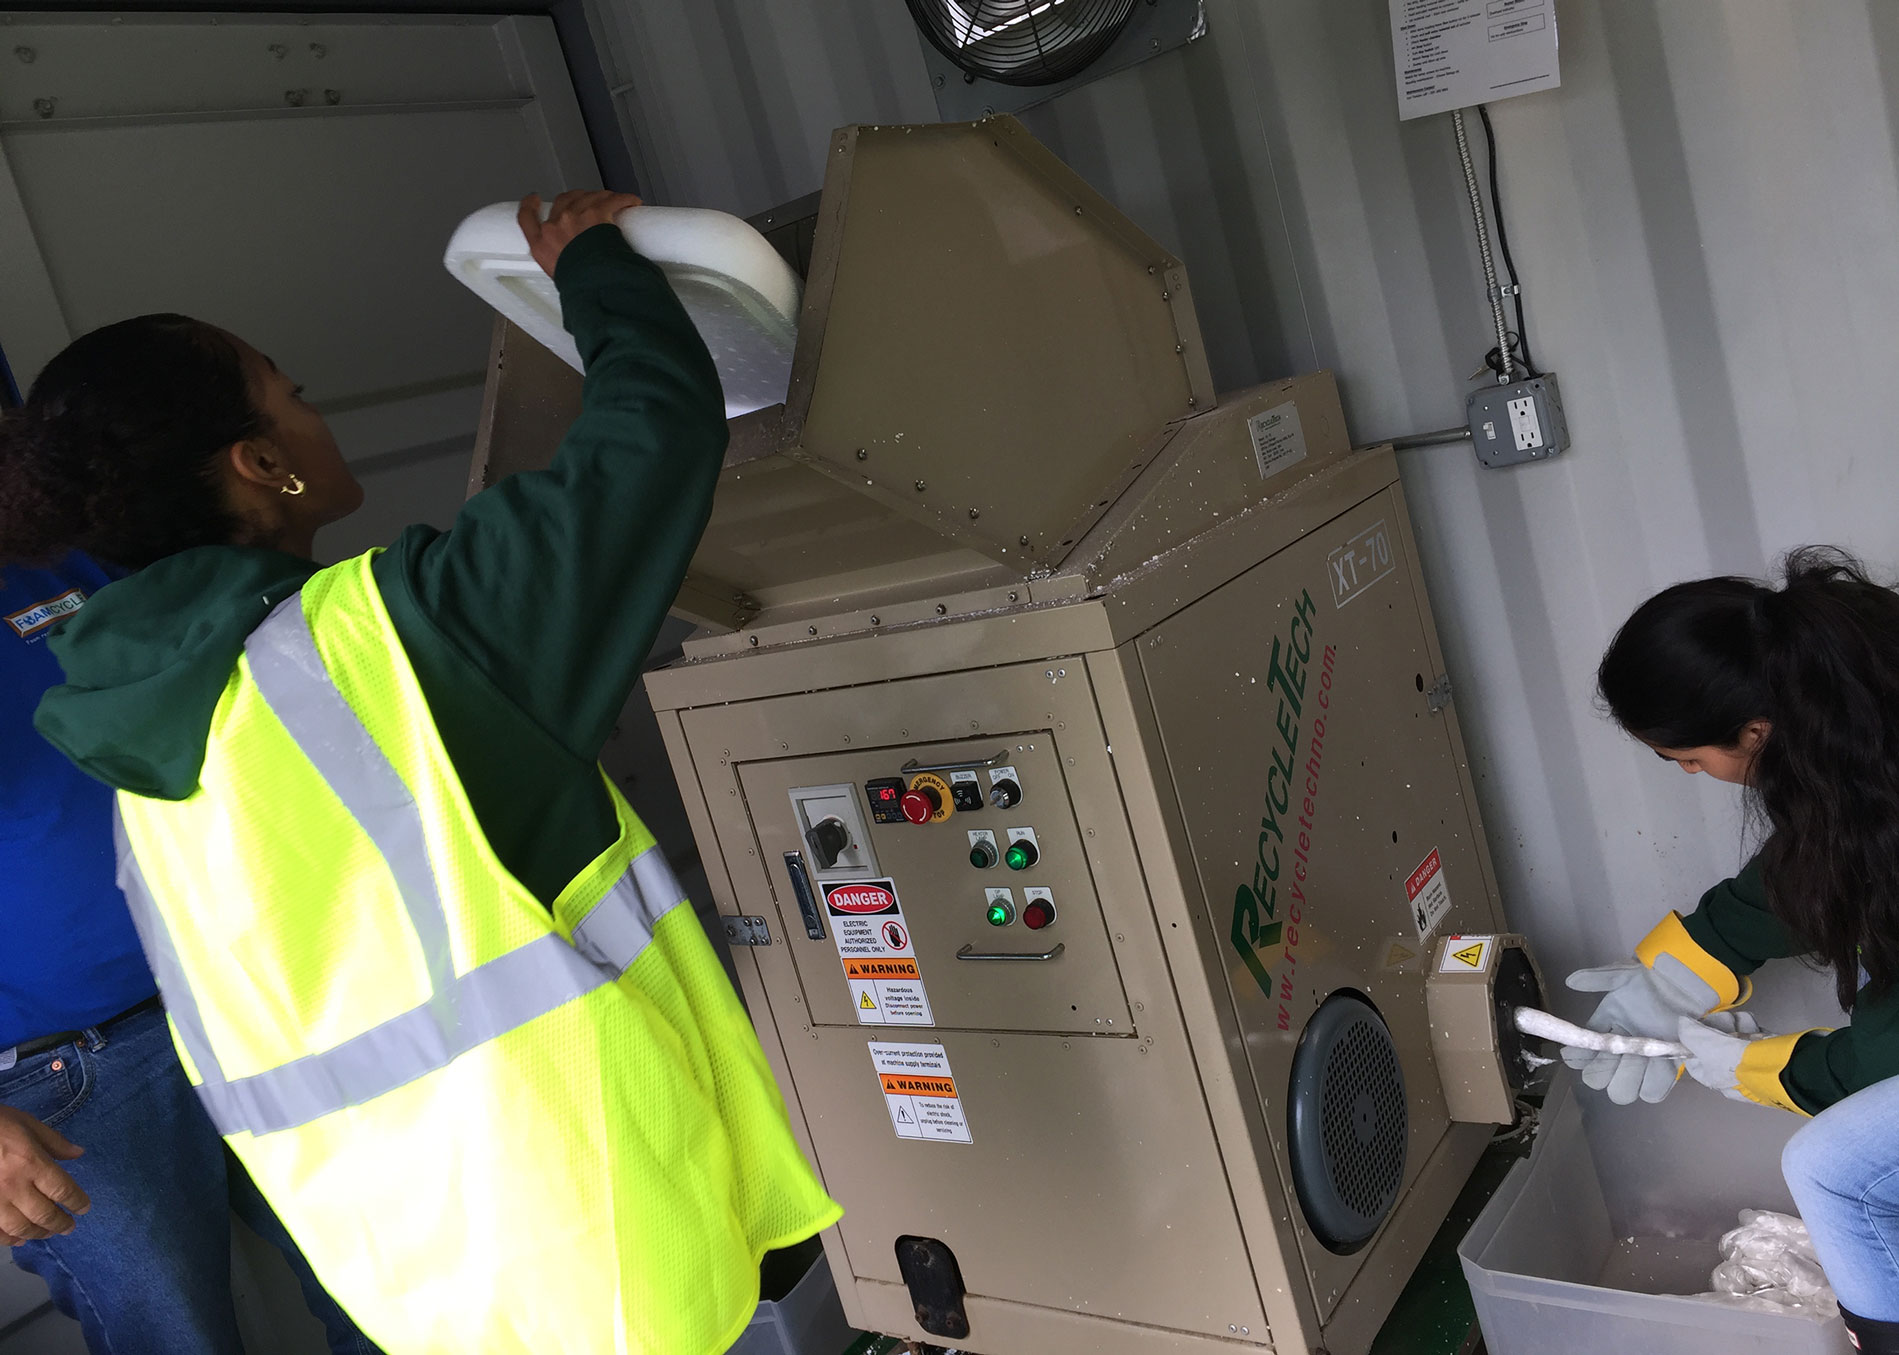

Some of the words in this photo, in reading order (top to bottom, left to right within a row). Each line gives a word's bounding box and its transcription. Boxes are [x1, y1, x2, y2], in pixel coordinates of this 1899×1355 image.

[1332, 531, 1389, 596] XT-70
[913, 776, 945, 791] MERGENCY
[880, 788, 896, 800] 167
[933, 810, 945, 819] TOP
[1414, 857, 1438, 886] DANGER
[834, 892, 888, 907] DANGER
[842, 920, 869, 928] ELECTRIC
[860, 964, 916, 975] WARNING
[901, 1049, 923, 1058] protection
[924, 1050, 944, 1059] provided
[920, 1061, 942, 1069] terminals
[896, 1080, 953, 1093] WARNING
